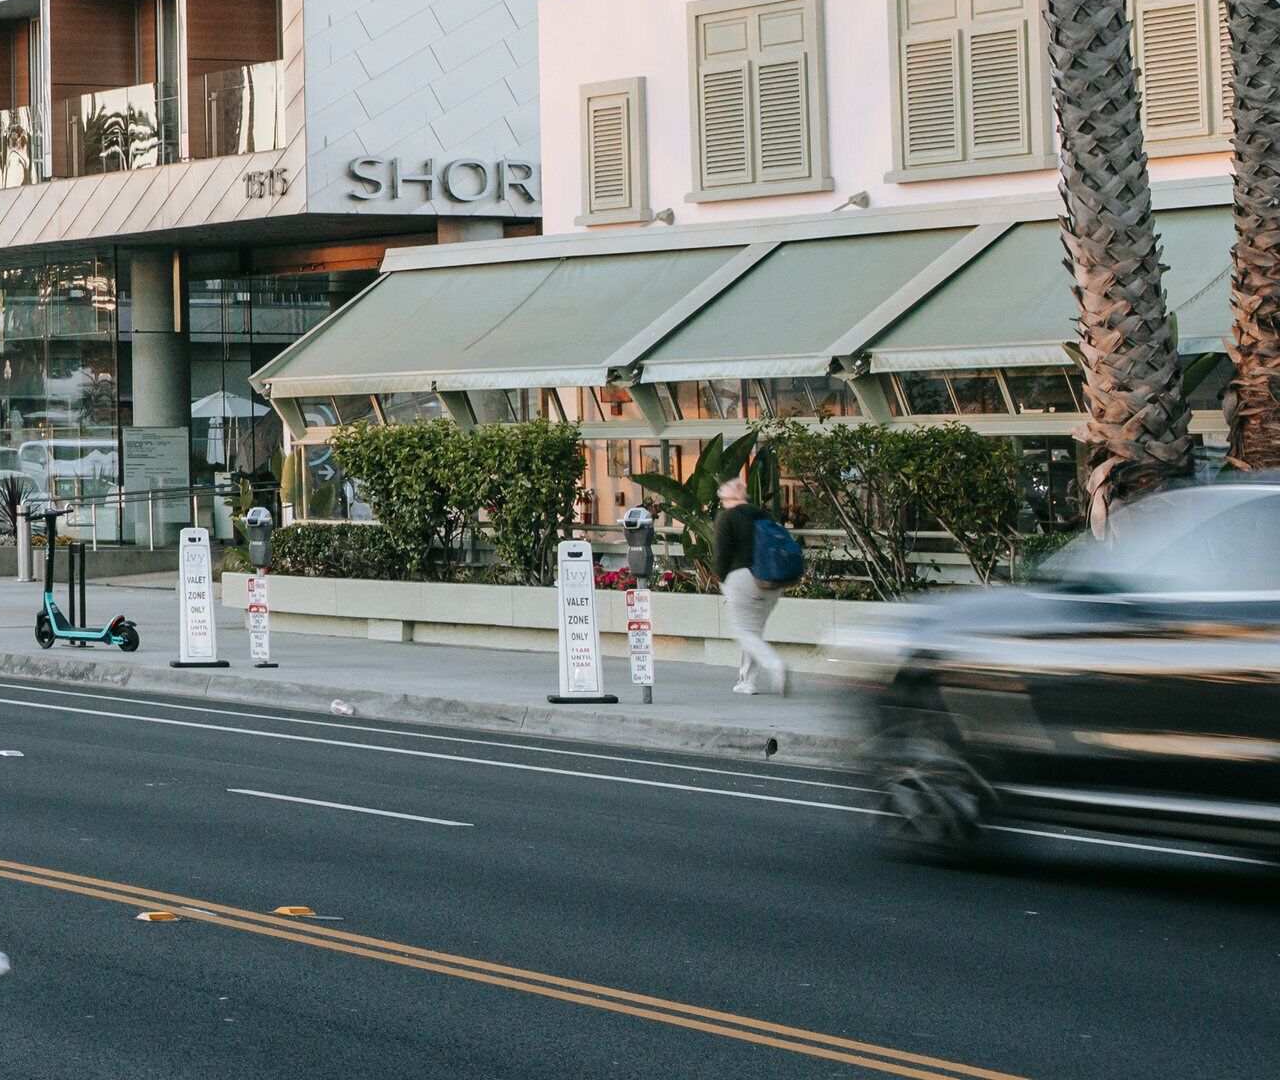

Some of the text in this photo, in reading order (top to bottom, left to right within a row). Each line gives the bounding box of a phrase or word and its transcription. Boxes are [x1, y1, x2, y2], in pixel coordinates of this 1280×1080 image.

[242, 167, 288, 200] 1515
[345, 155, 541, 203] SHOR
[187, 576, 206, 584] VALET
[566, 568, 587, 583] Ivy
[188, 591, 205, 600] ZONE
[566, 597, 589, 606] VALET
[190, 606, 205, 614] ONLY
[568, 615, 589, 624] ZONE
[571, 632, 588, 641] ONLY
